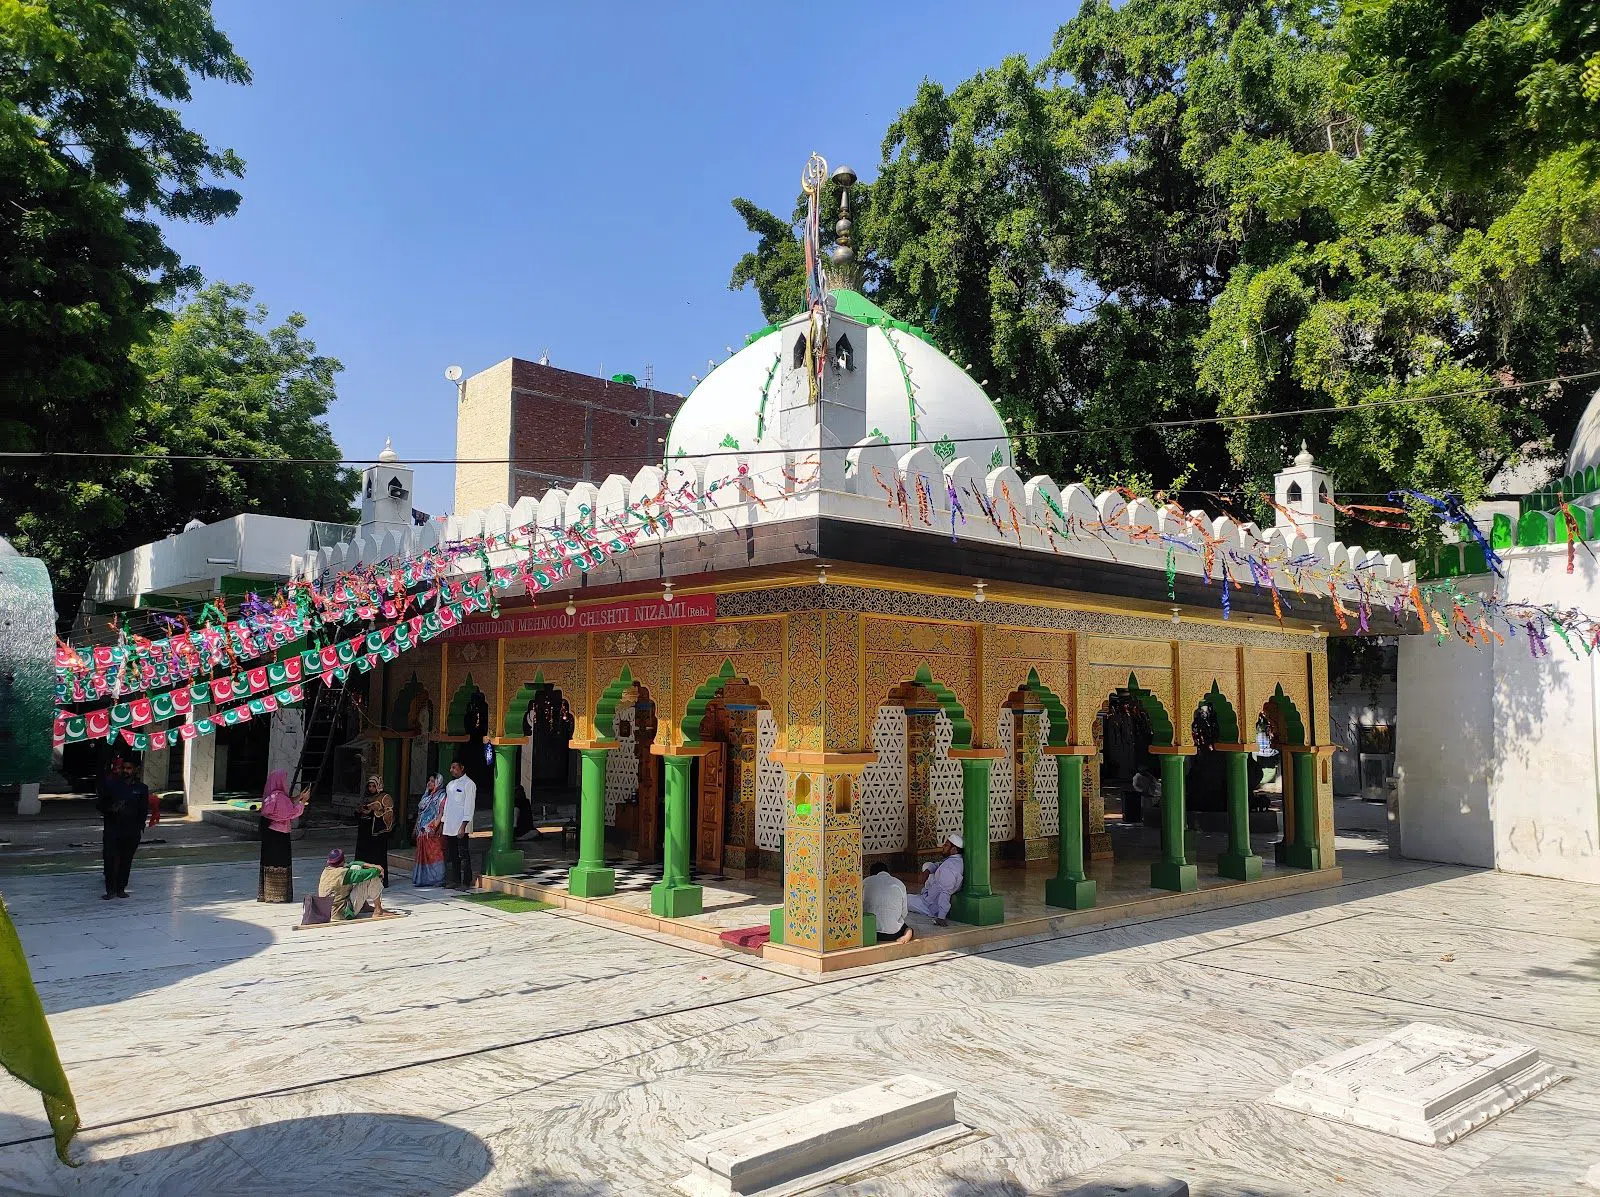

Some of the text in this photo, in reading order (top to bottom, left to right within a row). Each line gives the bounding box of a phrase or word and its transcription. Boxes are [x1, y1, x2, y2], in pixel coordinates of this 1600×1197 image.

[457, 620, 515, 637] NASIRUDDIN
[518, 614, 575, 632] MEHMOOD
[634, 602, 687, 622] NIZAMI
